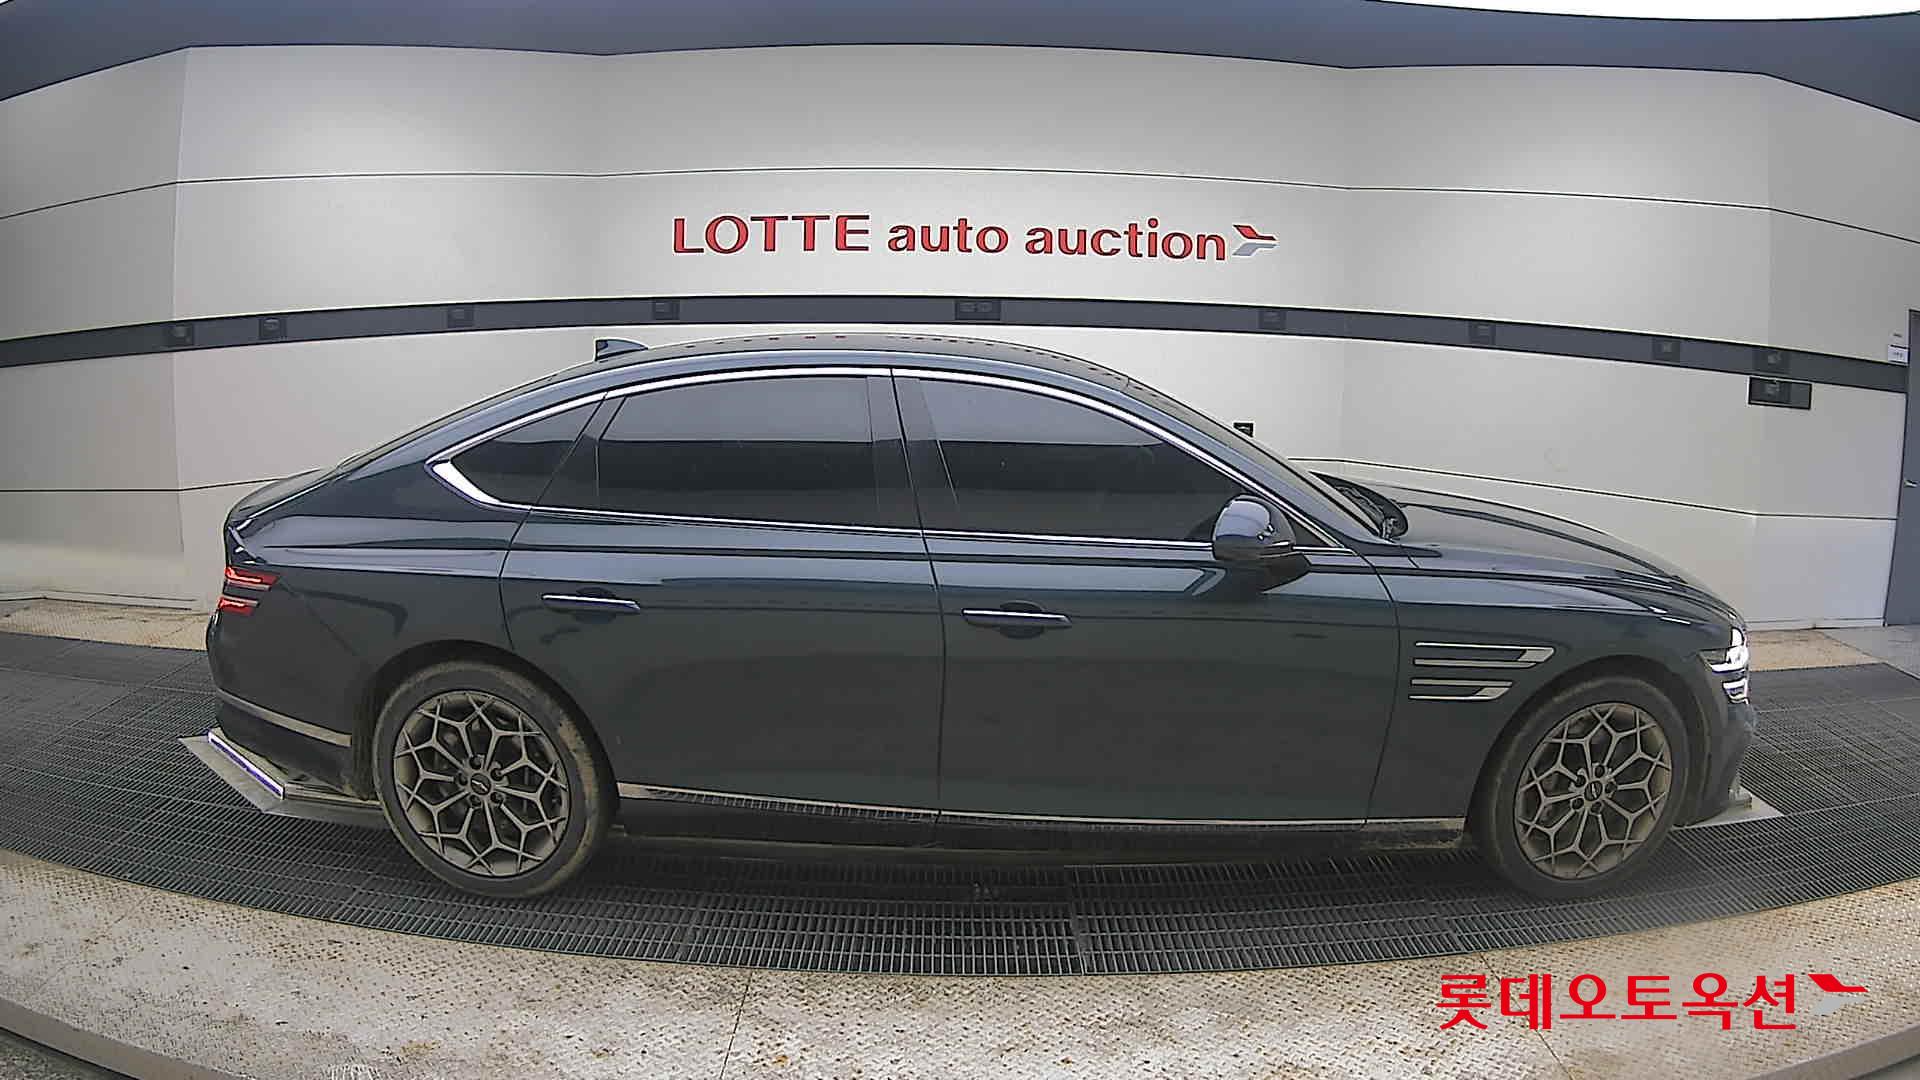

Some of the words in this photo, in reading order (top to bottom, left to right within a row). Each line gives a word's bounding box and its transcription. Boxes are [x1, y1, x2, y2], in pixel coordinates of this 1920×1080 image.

[673, 215, 870, 254] LOTTE
[887, 218, 1009, 253] auto
[1025, 218, 1226, 260] auction
